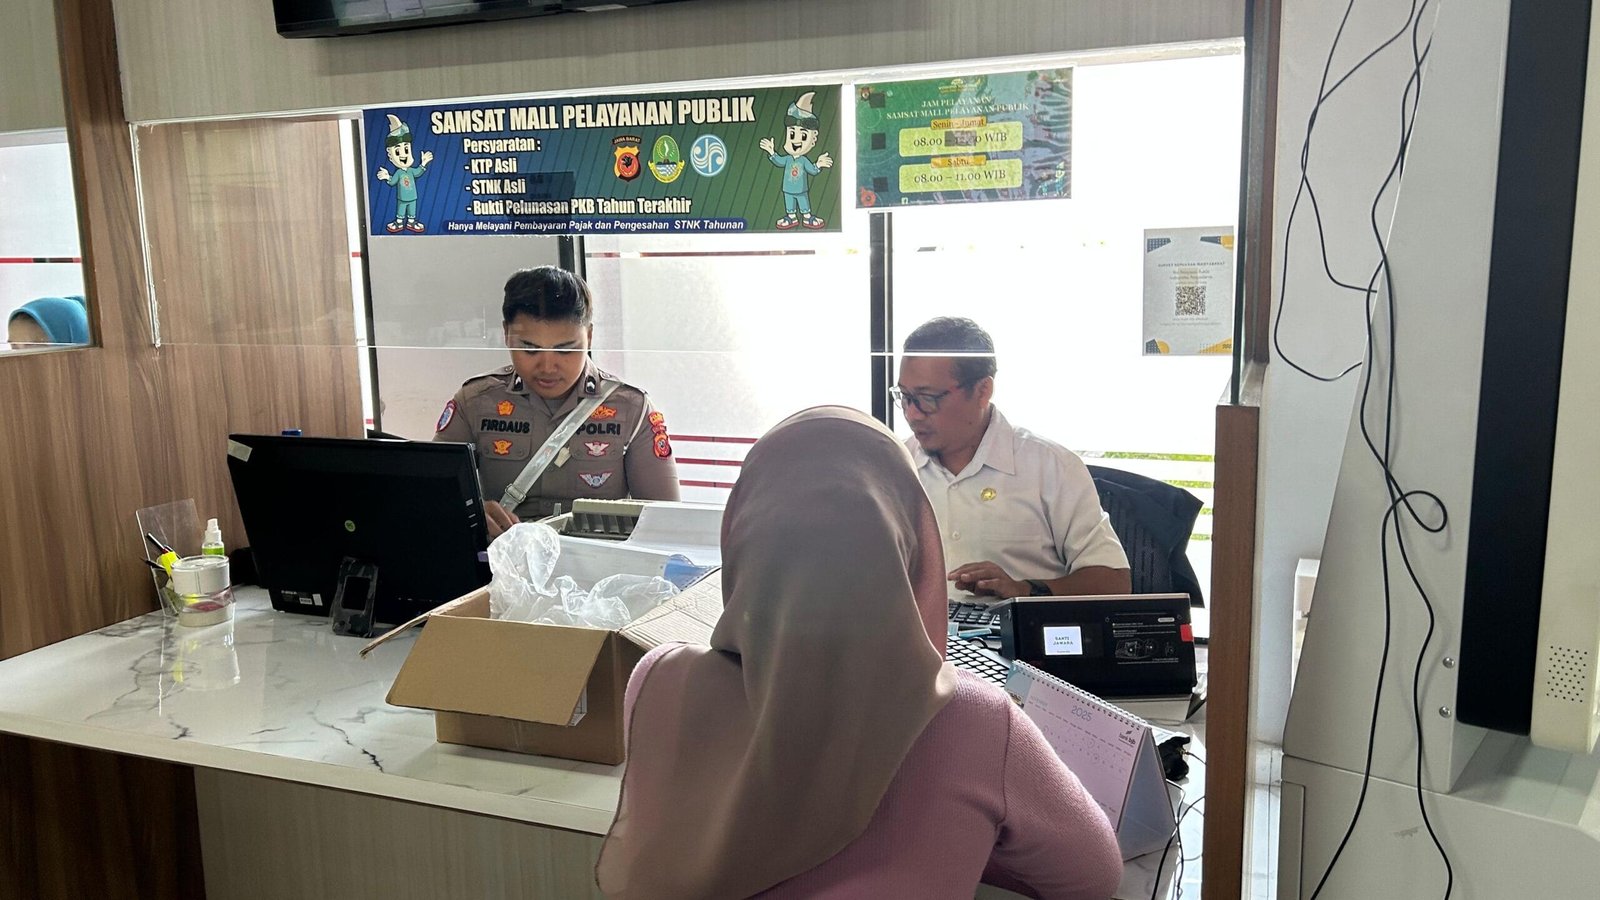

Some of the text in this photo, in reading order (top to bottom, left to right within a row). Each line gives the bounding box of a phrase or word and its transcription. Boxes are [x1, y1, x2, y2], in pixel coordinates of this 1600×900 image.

[921, 97, 991, 108] JAM PELAYANAN
[431, 96, 756, 134] SAMSAT MALL PELAYANAN PUBLIK
[886, 103, 1029, 119] SAMSAT MALL PELAYANAN PUBLIK
[463, 137, 535, 154] Persyaratan
[914, 137, 942, 147] 08.00
[985, 132, 1007, 142] WIB
[471, 159, 493, 174] KTP
[494, 157, 517, 173] Asli
[914, 174, 943, 184] 08.00
[956, 172, 980, 181] 11.00
[984, 170, 1006, 179] WIB
[472, 179, 501, 195] STNK
[503, 178, 526, 194] Asli
[473, 200, 504, 215] Bukti
[506, 199, 569, 215] Pelunasan
[570, 198, 595, 214] PKB
[597, 199, 635, 214] Tahun
[636, 197, 692, 213] Terakhir
[448, 219, 744, 232] Hanya Melayani Pembayaran Pajak dan Pengesahan STNK Tahunan
[481, 419, 530, 434] FIRDAUS
[576, 423, 620, 435] POLRI
[1071, 705, 1093, 722] 2025
